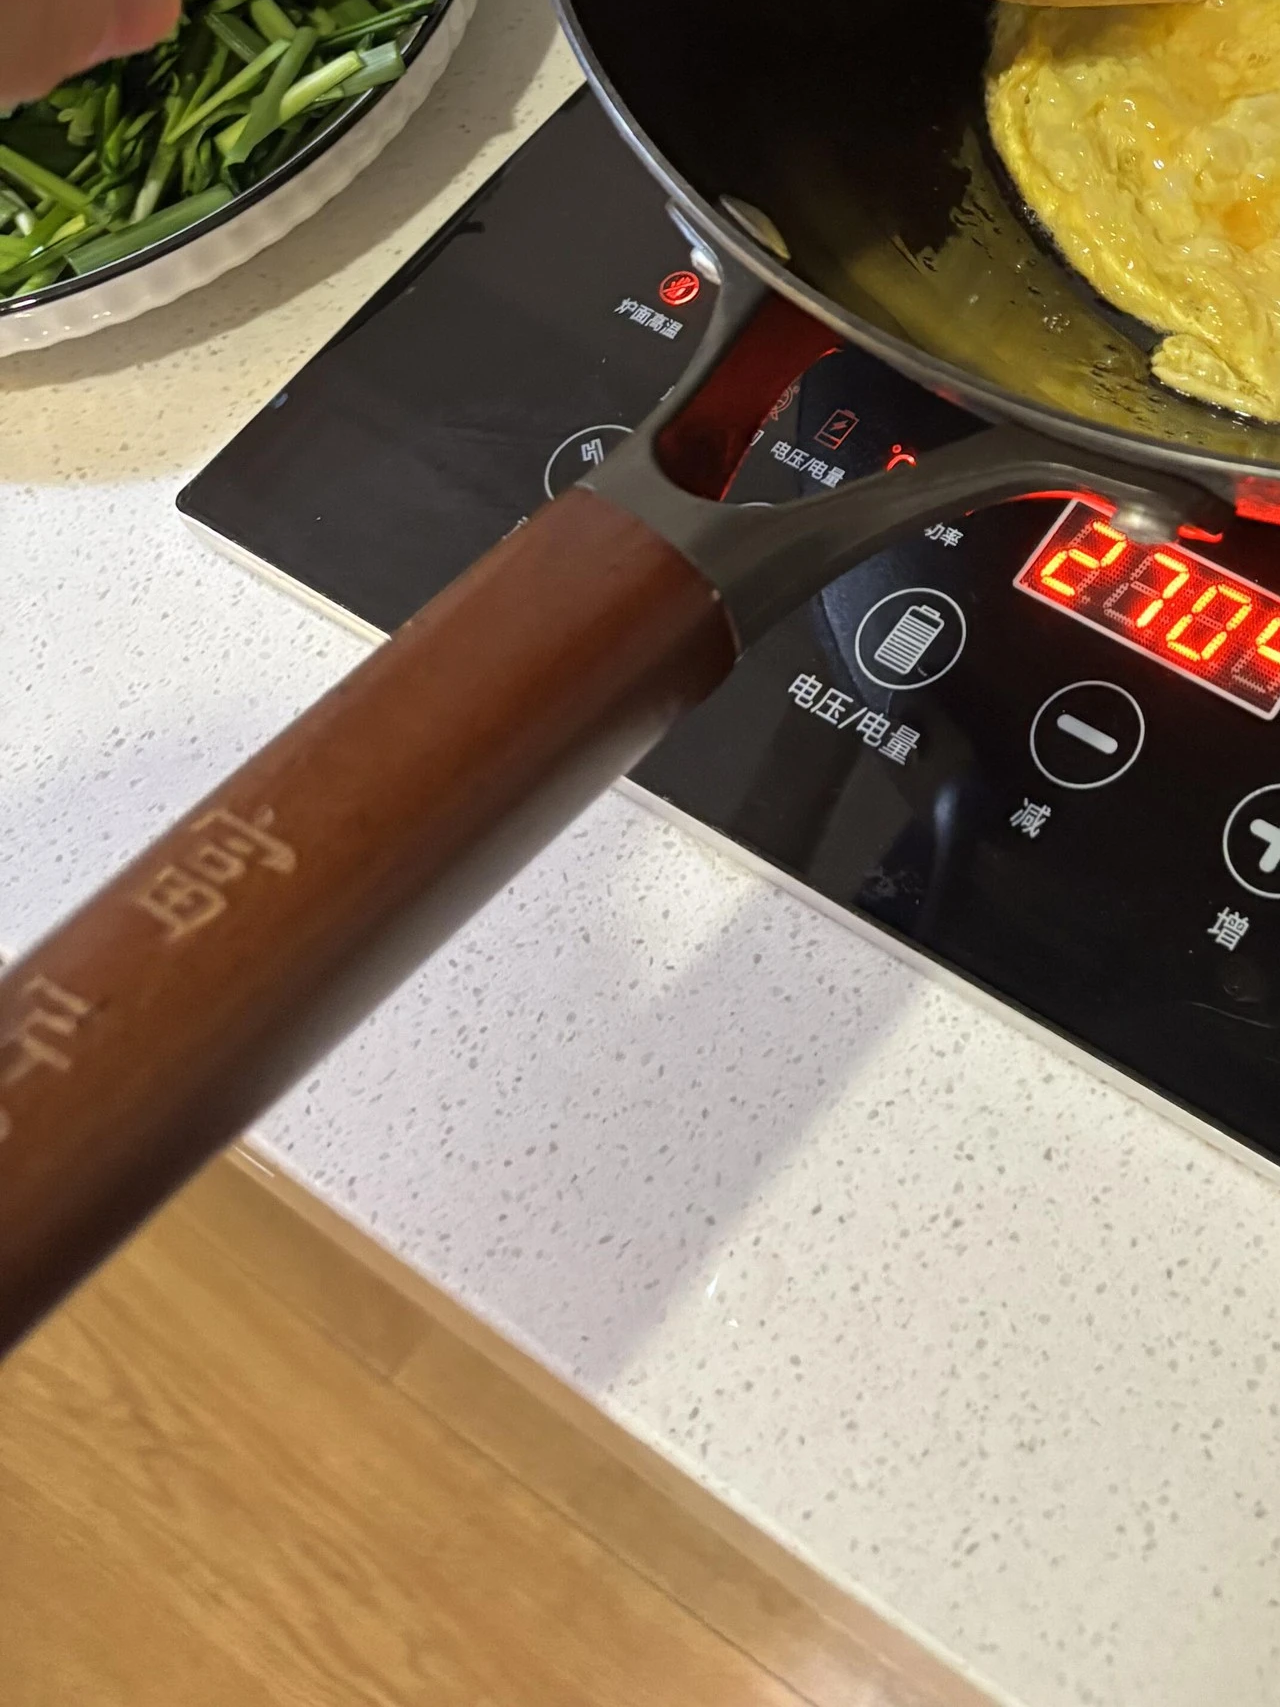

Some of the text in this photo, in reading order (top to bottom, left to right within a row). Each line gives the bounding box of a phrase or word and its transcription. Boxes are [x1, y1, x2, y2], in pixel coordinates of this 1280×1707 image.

[614, 297, 683, 340] 炉面高温
[771, 440, 846, 489] 电压/电量
[787, 671, 920, 765] 电压/电量
[1009, 797, 1053, 839] 减
[1207, 906, 1250, 952] 增
